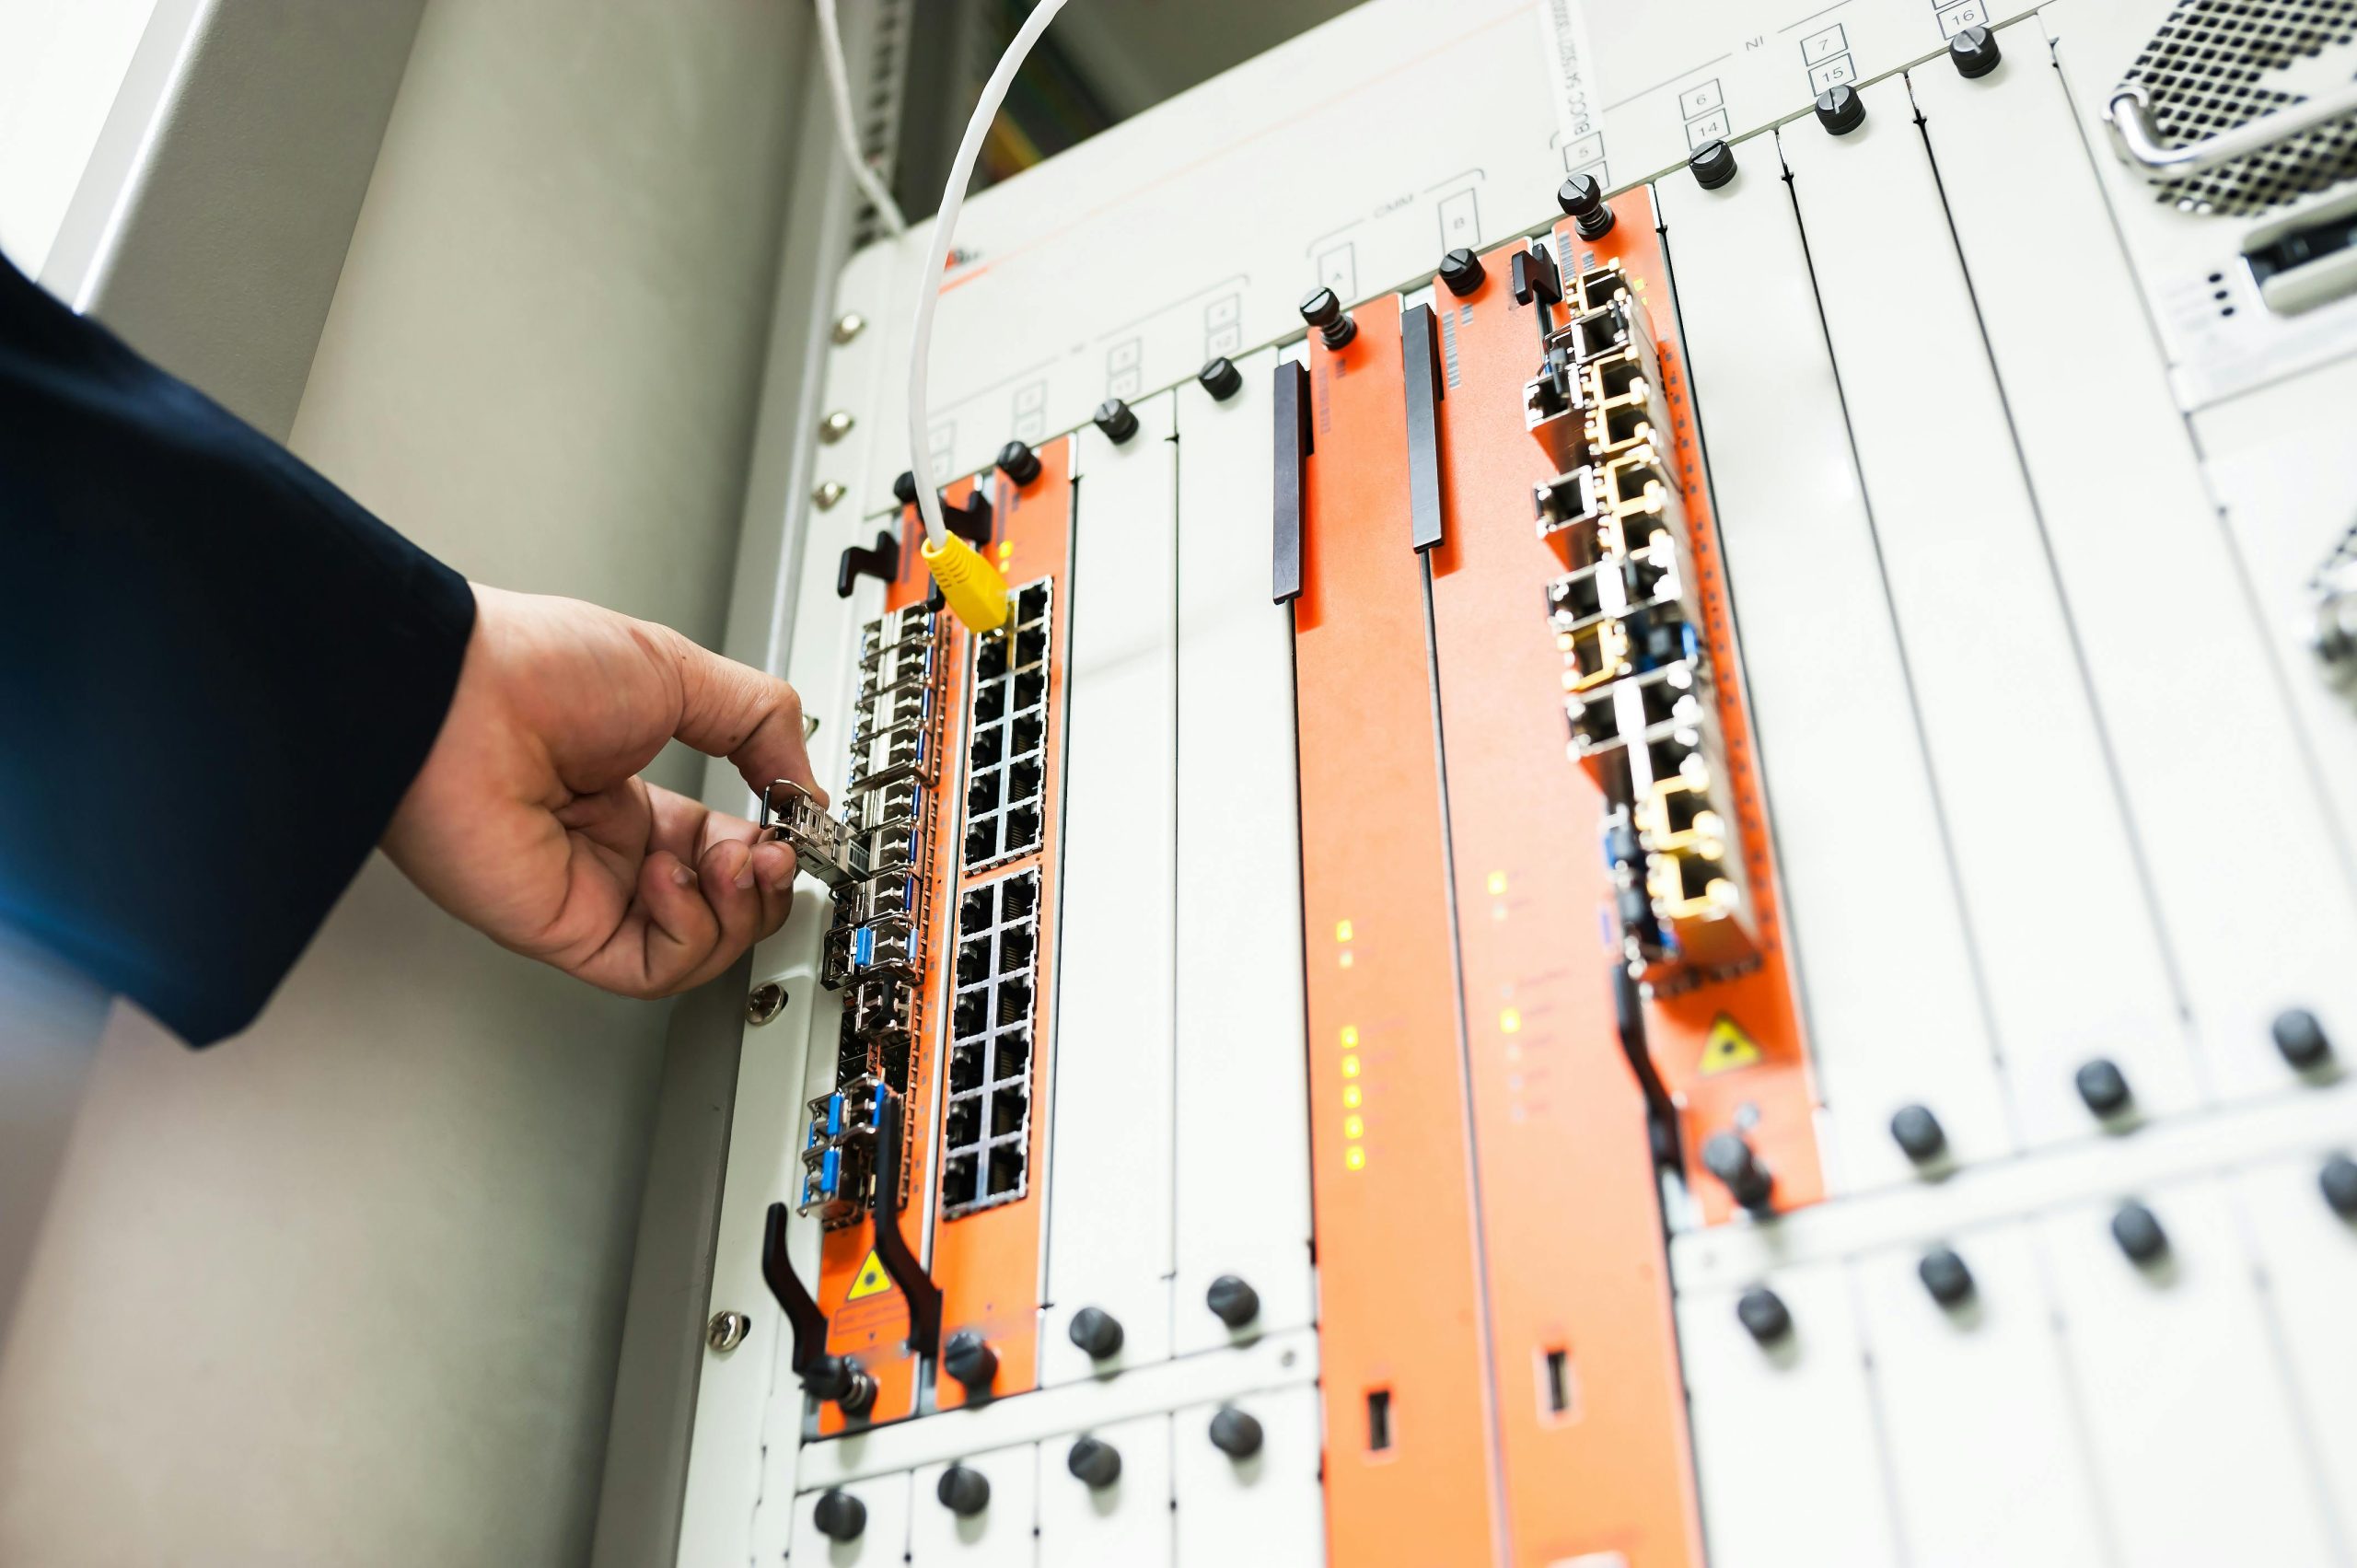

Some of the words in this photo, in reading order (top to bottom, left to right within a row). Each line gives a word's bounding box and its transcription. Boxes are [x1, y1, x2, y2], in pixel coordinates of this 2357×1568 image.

[1951, 9, 1975, 26] 16
[1745, 35, 1764, 52] NI
[1817, 38, 1829, 52] 7
[1821, 66, 1844, 83] 15
[1696, 94, 1707, 107] 6
[1698, 122, 1720, 137] 14
